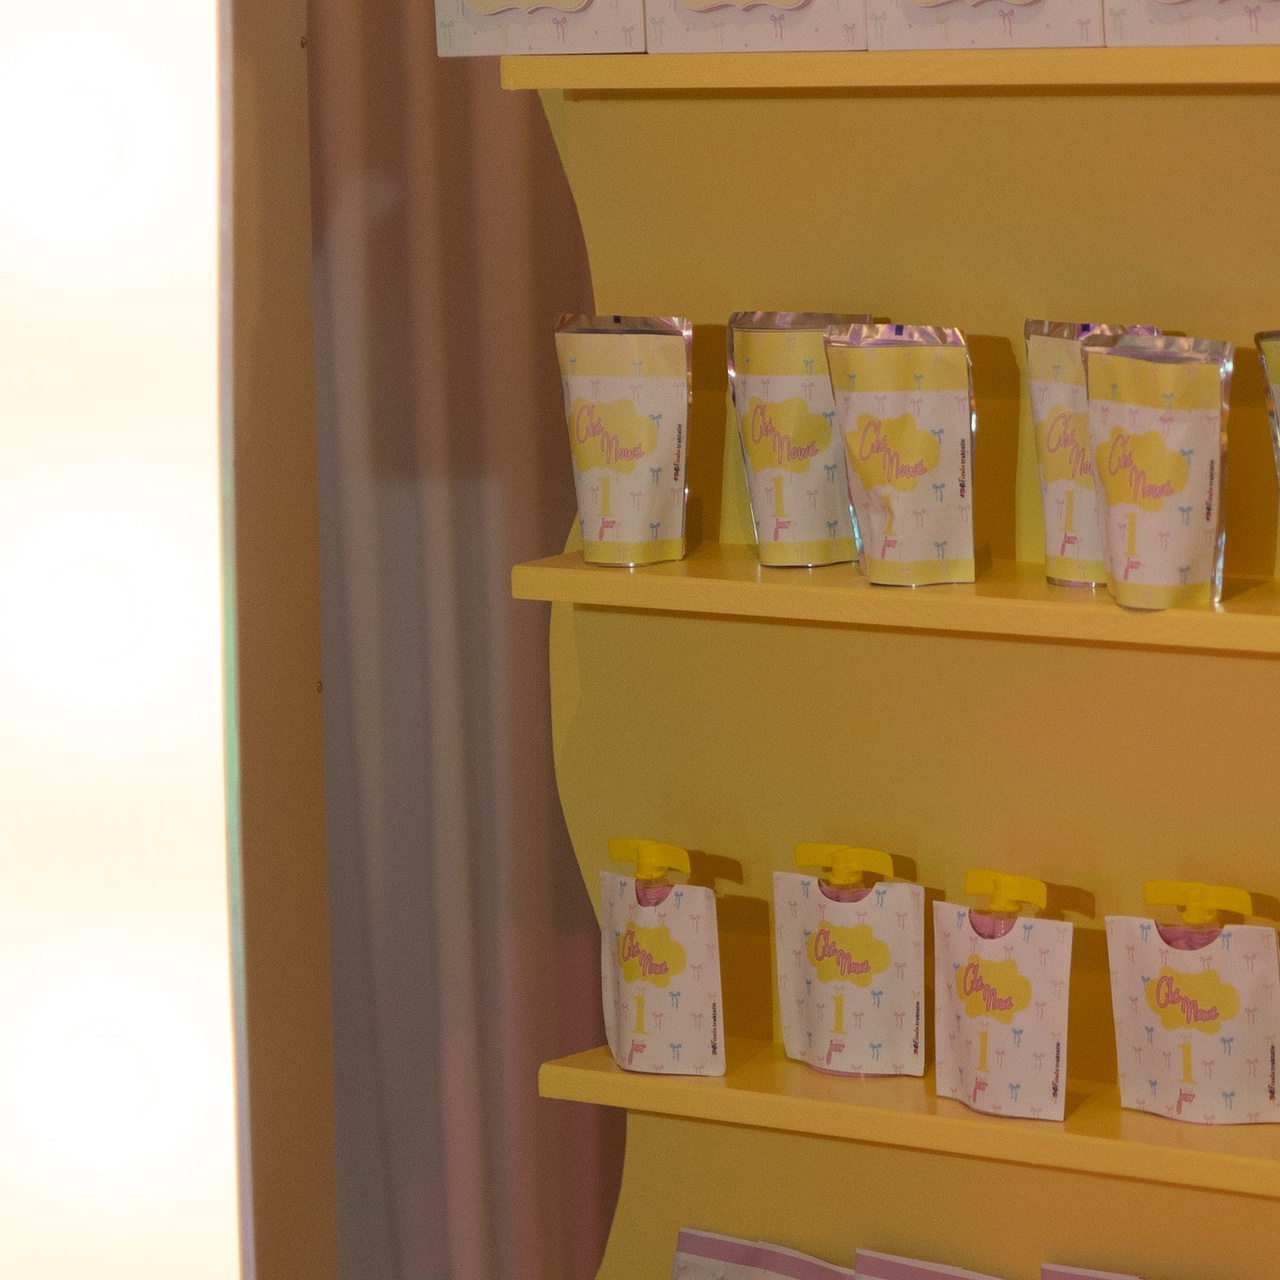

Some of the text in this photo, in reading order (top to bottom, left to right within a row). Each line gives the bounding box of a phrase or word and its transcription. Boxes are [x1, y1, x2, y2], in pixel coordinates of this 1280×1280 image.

[634, 996, 646, 1034] 1
[831, 996, 844, 1034] 1
[976, 1031, 989, 1071] 1
[1179, 1043, 1195, 1084] 1
